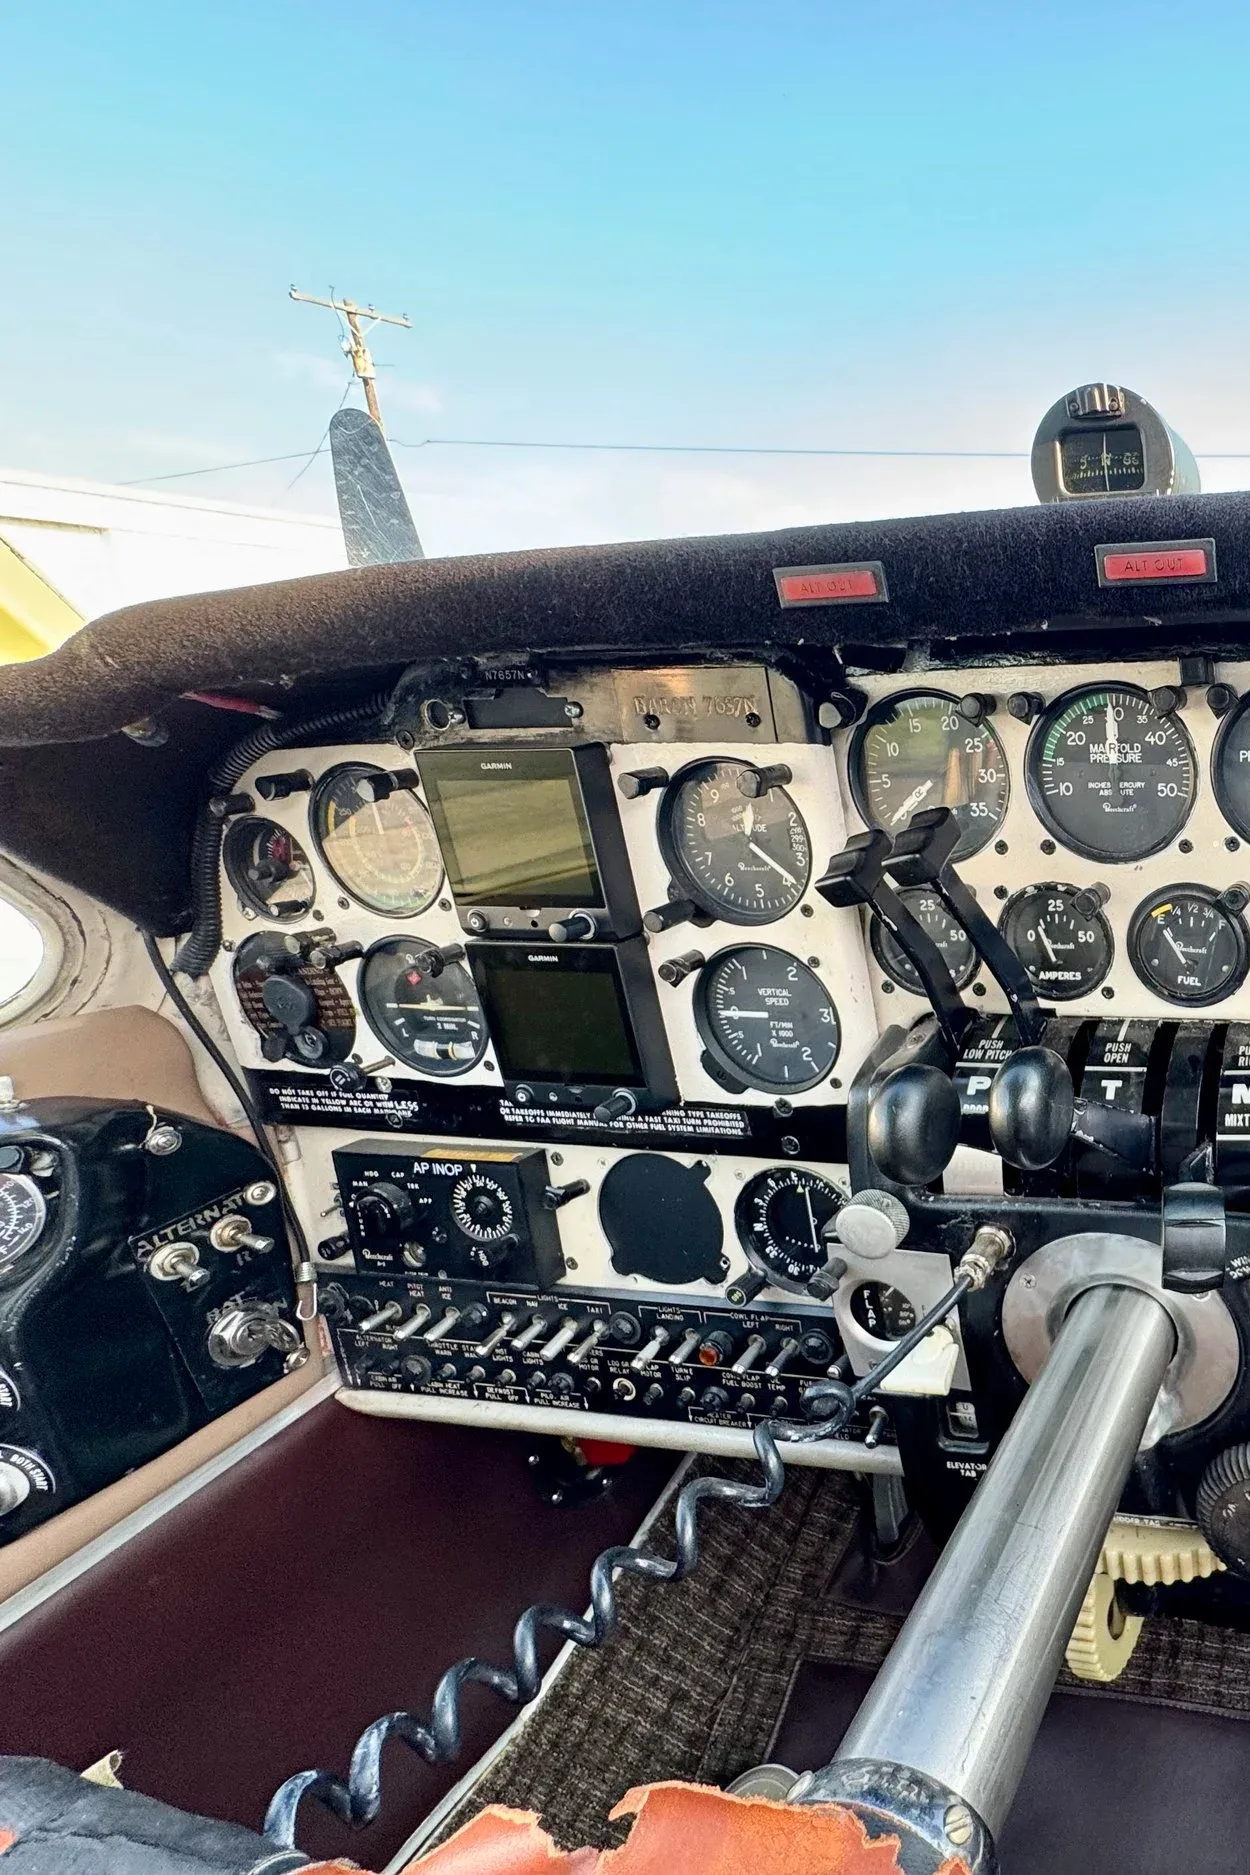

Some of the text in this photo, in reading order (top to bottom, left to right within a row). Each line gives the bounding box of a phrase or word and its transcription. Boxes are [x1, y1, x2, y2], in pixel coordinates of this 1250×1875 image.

[1124, 557, 1184, 572] ALT OUT
[800, 580, 853, 593] ALT OUT
[485, 670, 525, 681] N7657N
[941, 717, 959, 731] 20
[1082, 716, 1094, 724] 25
[1137, 715, 1148, 724] 35
[908, 719, 922, 733] 15
[1066, 731, 1086, 745] 20
[1145, 731, 1167, 745] 40
[887, 742, 900, 757] 10
[965, 738, 983, 753] 25
[480, 762, 512, 770] GARMIN
[1056, 758, 1064, 766] 15
[1166, 758, 1179, 767] 45
[978, 769, 997, 783] 30
[1059, 782, 1073, 796] 10
[1157, 783, 1178, 797] 50
[970, 802, 989, 816] 35
[920, 900, 935, 911] 25
[1048, 900, 1064, 911] 25
[950, 930, 966, 942] 50
[1078, 931, 1095, 943] 50
[528, 954, 558, 963] GARMIN
[1038, 971, 1082, 981] AMPERES
[1178, 976, 1201, 986] FUEL
[758, 988, 793, 997] VERTICAL
[765, 997, 789, 1006] SPEED
[978, 1039, 1004, 1049] PUSH
[1105, 1042, 1131, 1053] PUSH
[963, 1049, 985, 1059] LOW
[1104, 1053, 1129, 1063] OPEN
[967, 1076, 992, 1095] P
[1101, 1080, 1123, 1100] T
[282, 1087, 295, 1095] NOT
[356, 1092, 389, 1100] QUANTITY
[279, 1095, 310, 1104] INDICATE
[322, 1098, 346, 1106] YELLOW
[395, 1101, 419, 1111] LESS
[311, 1104, 342, 1112] GALLONS
[354, 1106, 371, 1114] EACH
[512, 1108, 545, 1116] TAKEOFFS
[546, 1110, 590, 1119] IMMEDIATELY
[704, 1119, 744, 1128] PROHIBITED
[707, 1111, 741, 1120] TAKEOFFS
[552, 1117, 574, 1125] FLIGHT
[668, 1124, 694, 1132] SYSTEM
[413, 1162, 463, 1176] AP INOP
[656, 1313, 684, 1321] LANDING
[742, 1321, 759, 1329] LEFT
[775, 1324, 794, 1332] RIGHT
[946, 1461, 987, 1471] ELEVATOR
[9, 1453, 48, 1491] BOTH START
[960, 1469, 977, 1478] TAB
